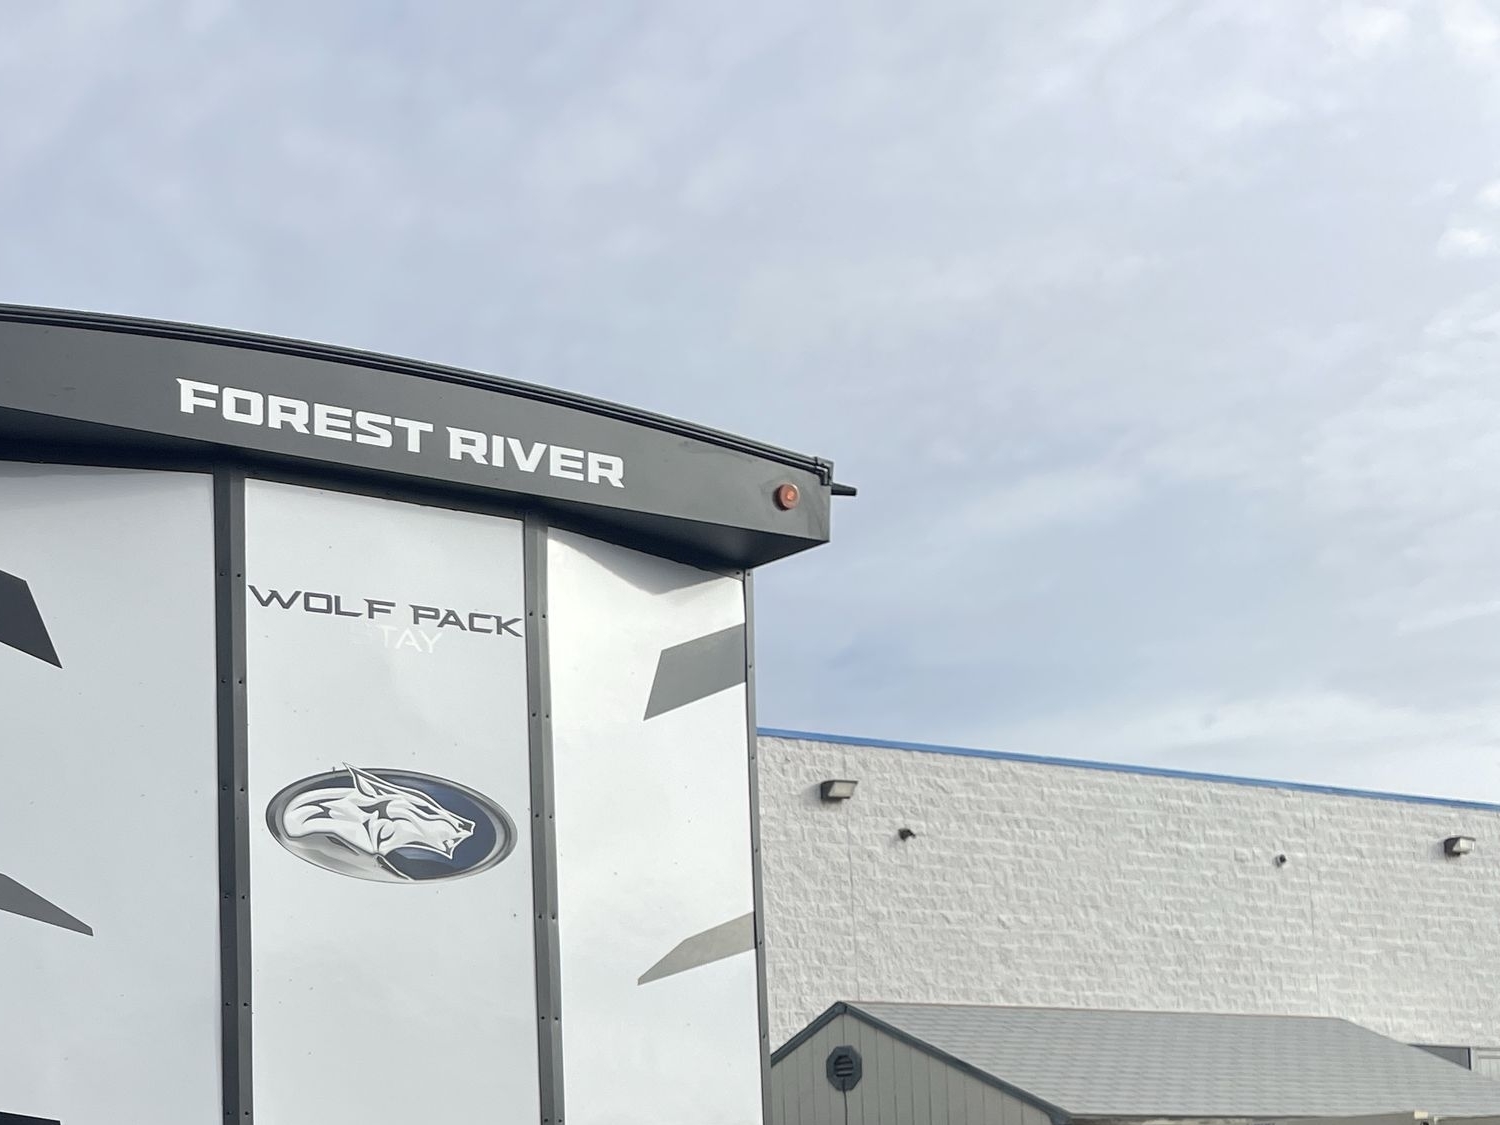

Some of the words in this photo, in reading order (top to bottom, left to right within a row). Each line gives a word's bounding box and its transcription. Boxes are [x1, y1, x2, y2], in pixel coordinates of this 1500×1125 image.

[175, 377, 433, 453] FOREST
[445, 426, 625, 489] RIVER
[248, 584, 396, 620] WOLF
[408, 604, 523, 637] PACK
